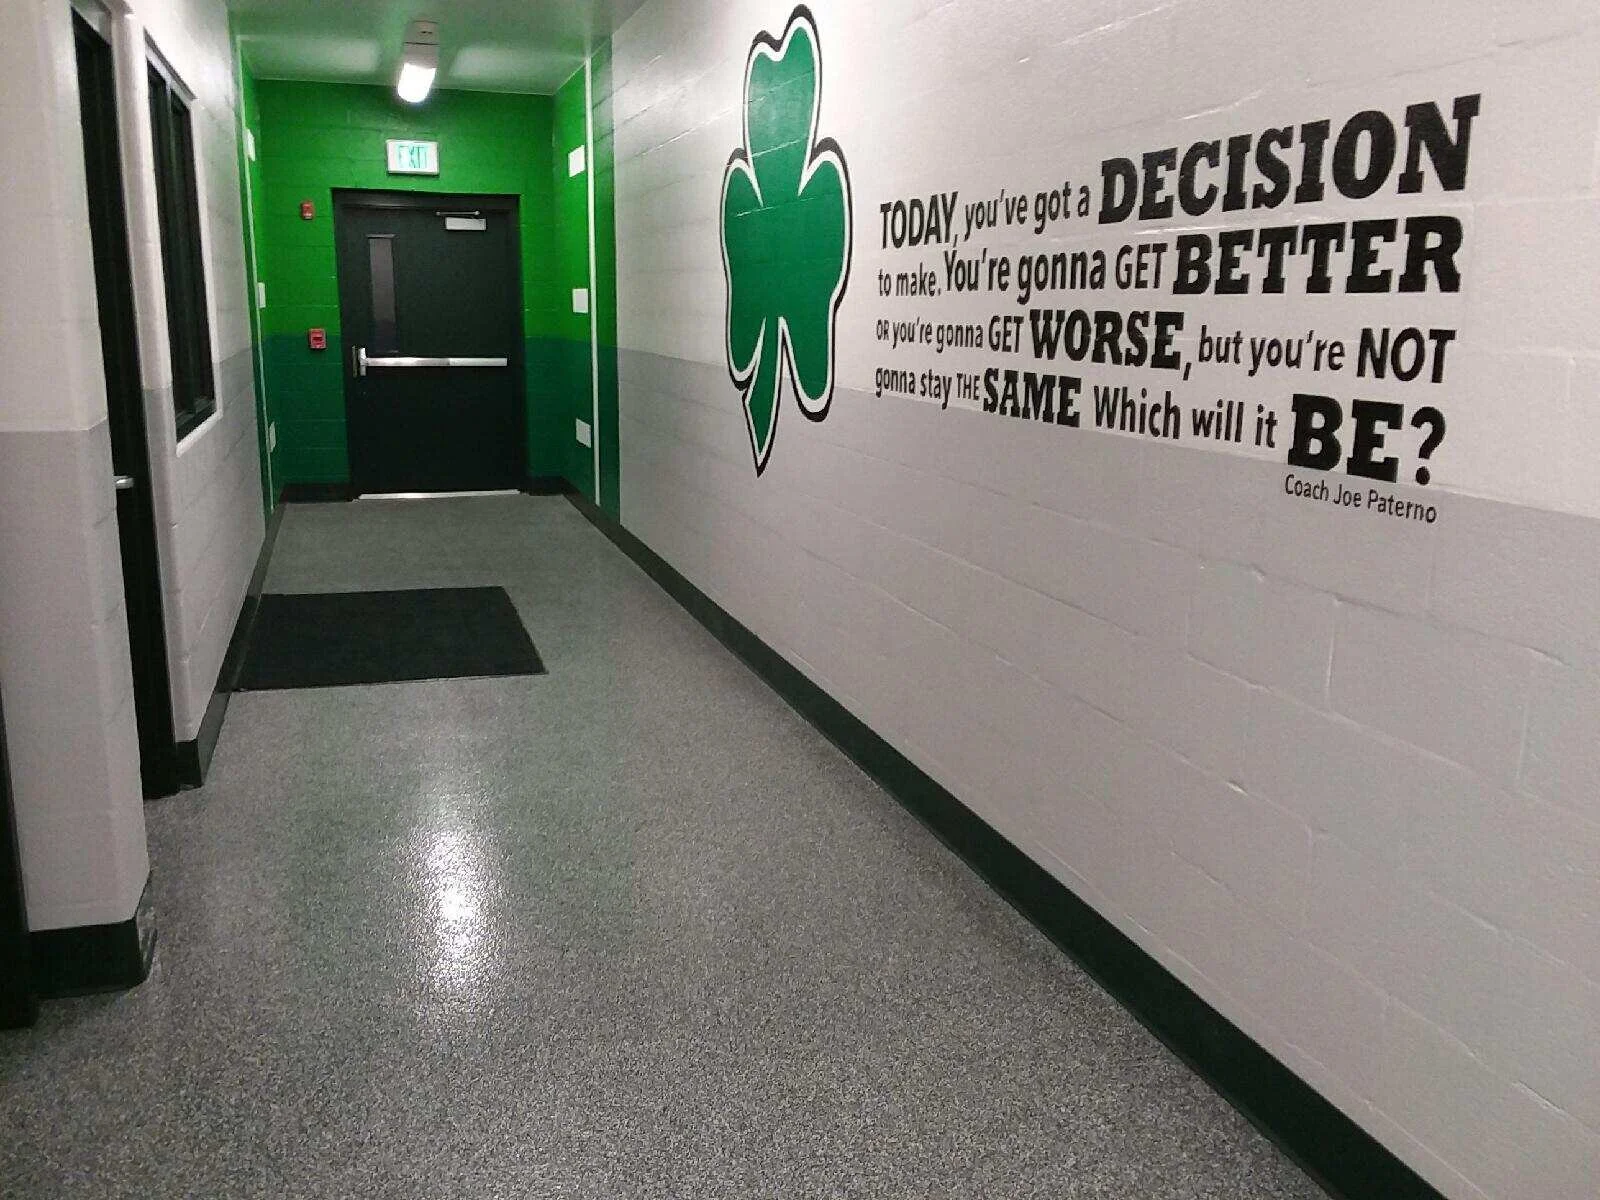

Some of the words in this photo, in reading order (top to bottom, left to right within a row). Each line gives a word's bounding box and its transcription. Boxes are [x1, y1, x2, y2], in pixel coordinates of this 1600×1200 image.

[880, 191, 959, 249] TODAY,
[964, 189, 1028, 242] you've
[1034, 181, 1072, 235] got
[1077, 185, 1090, 218] a
[1098, 93, 1481, 225] DECISION
[878, 268, 892, 297] to
[895, 262, 942, 297] make.
[944, 248, 1010, 292] You're
[1016, 249, 1107, 305] gonna
[1115, 242, 1169, 290] GET
[1172, 215, 1464, 295] BETTER
[876, 318, 890, 341] OR
[892, 316, 933, 350] you're
[936, 323, 984, 354] gonna
[988, 315, 1025, 353] GET
[1028, 308, 1192, 381] WORSE,
[1198, 324, 1243, 366] but
[1247, 330, 1346, 378] you're
[1356, 327, 1457, 384] NOT
[875, 367, 916, 399] gonna
[919, 368, 953, 411] stay
[956, 373, 981, 401] THE
[982, 367, 1082, 429] SAME
[1093, 384, 1181, 440] Which
[1191, 398, 1245, 443] will
[1254, 403, 1279, 449] it
[1287, 393, 1447, 484] BE?
[1284, 473, 1331, 502] Coach
[1332, 483, 1364, 508] Joe
[1367, 488, 1438, 524] Paterno
